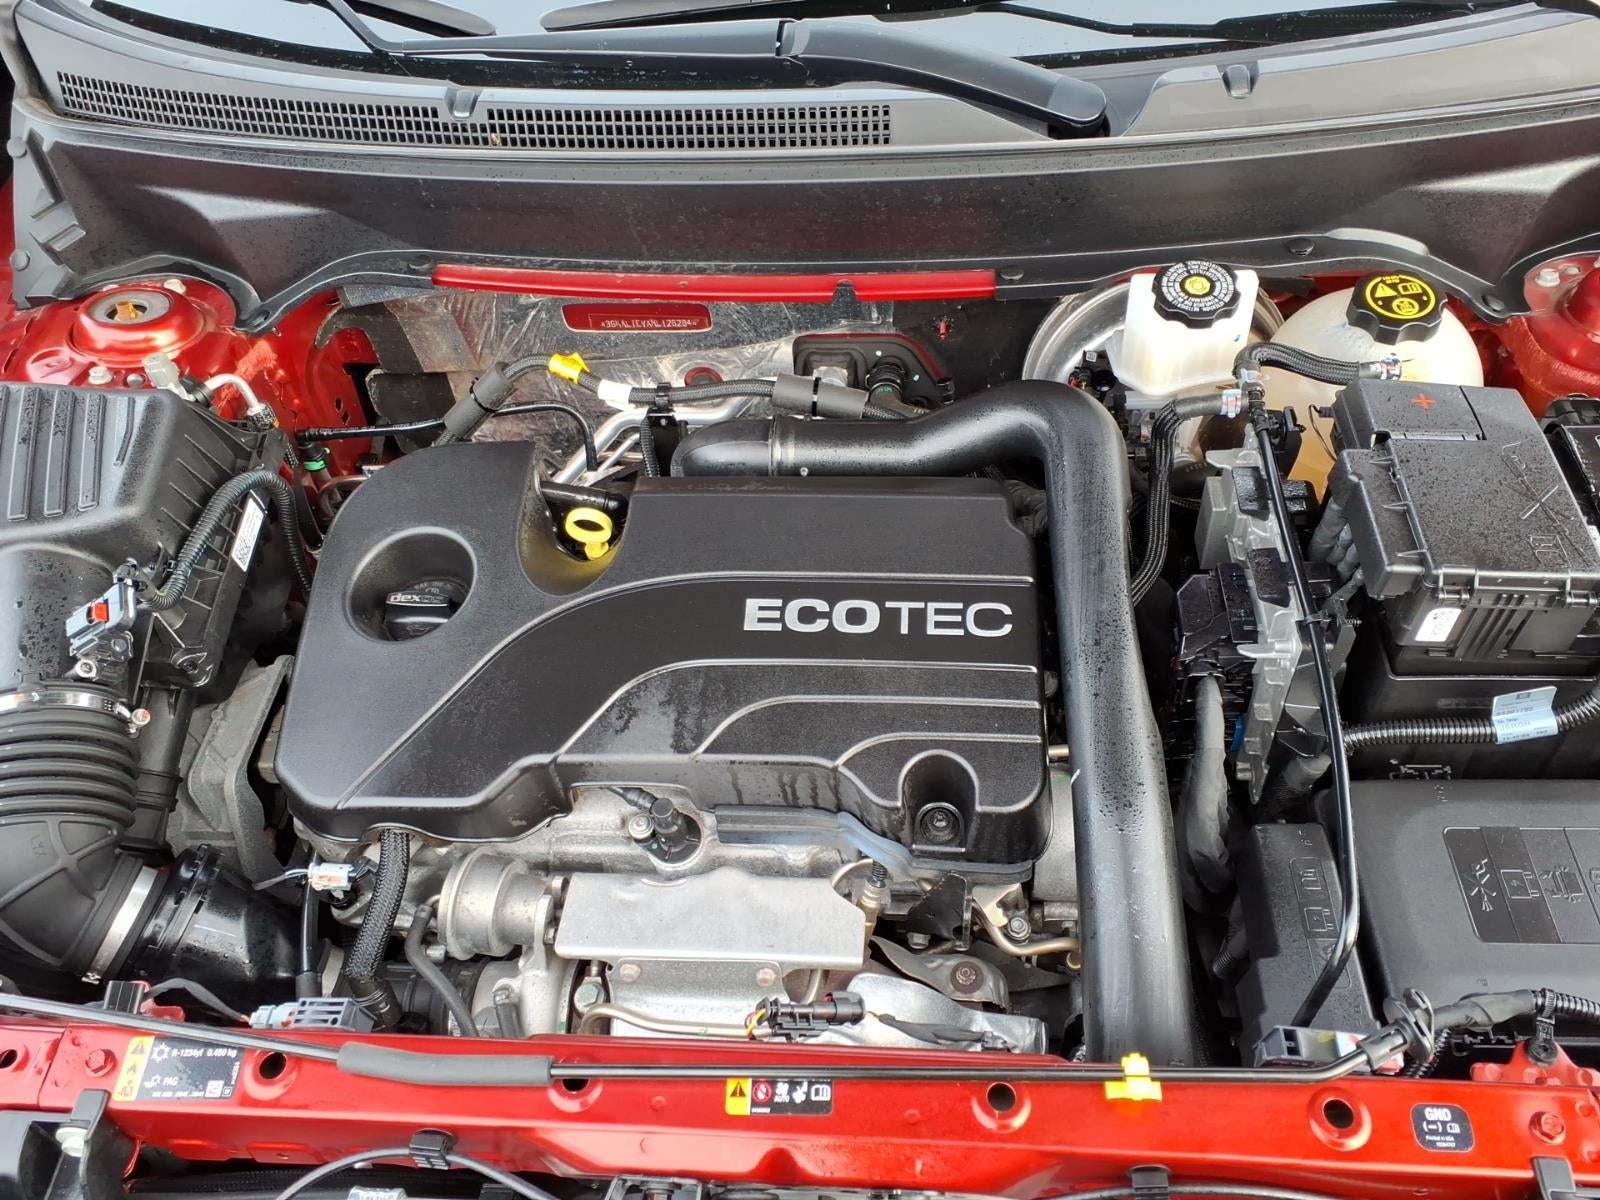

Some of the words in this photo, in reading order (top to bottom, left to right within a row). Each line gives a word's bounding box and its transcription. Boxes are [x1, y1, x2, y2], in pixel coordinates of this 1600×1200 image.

[743, 598, 1013, 637] ECOTEC
[774, 1095, 790, 1103] AUTO
[1425, 1107, 1451, 1121] GND
